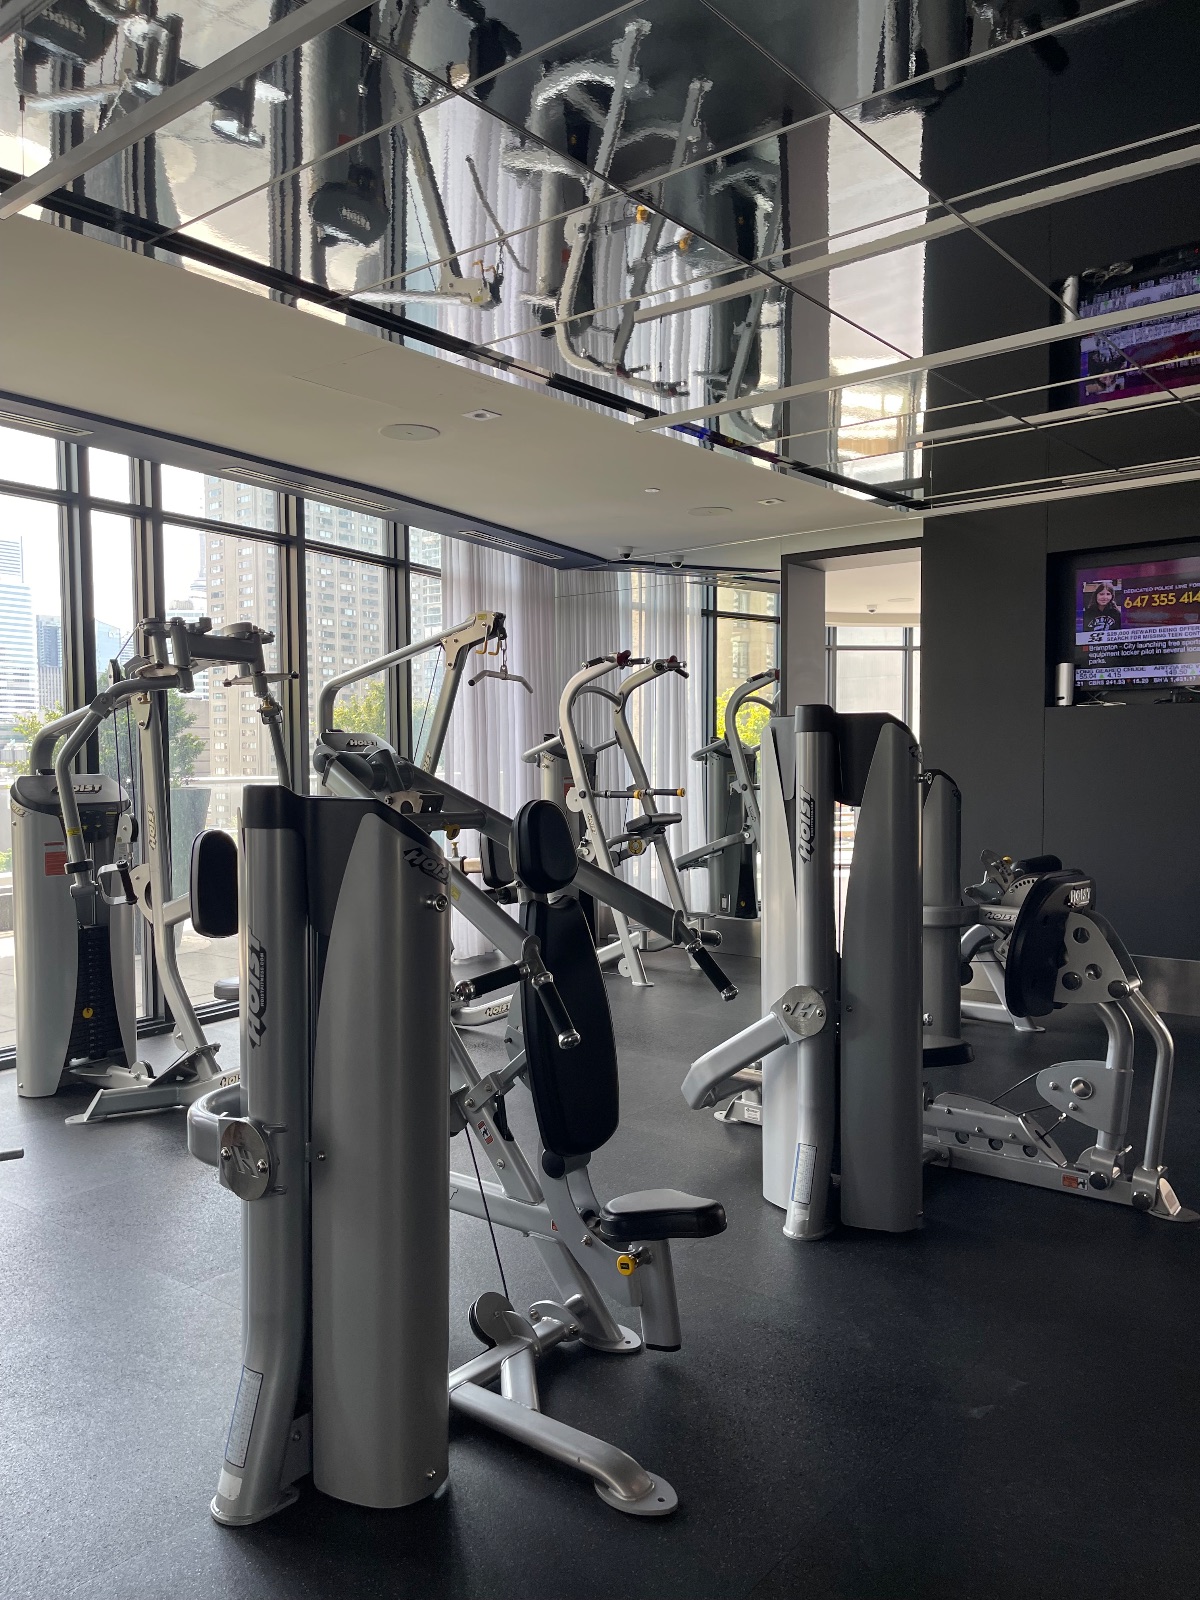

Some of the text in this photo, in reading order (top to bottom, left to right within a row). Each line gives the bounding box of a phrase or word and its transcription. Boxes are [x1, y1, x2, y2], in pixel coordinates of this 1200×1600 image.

[1124, 591, 1200, 609] 647 355 414
[1123, 642, 1136, 650] City
[1137, 641, 1167, 649] launching
[1141, 648, 1155, 656] pilot
[799, 785, 811, 862] HOIST
[403, 850, 450, 879] HOIS
[1070, 887, 1091, 903] HOIST
[986, 911, 1017, 921] HOIST
[248, 924, 261, 1047] HOIST
[220, 1074, 240, 1088] HOI
